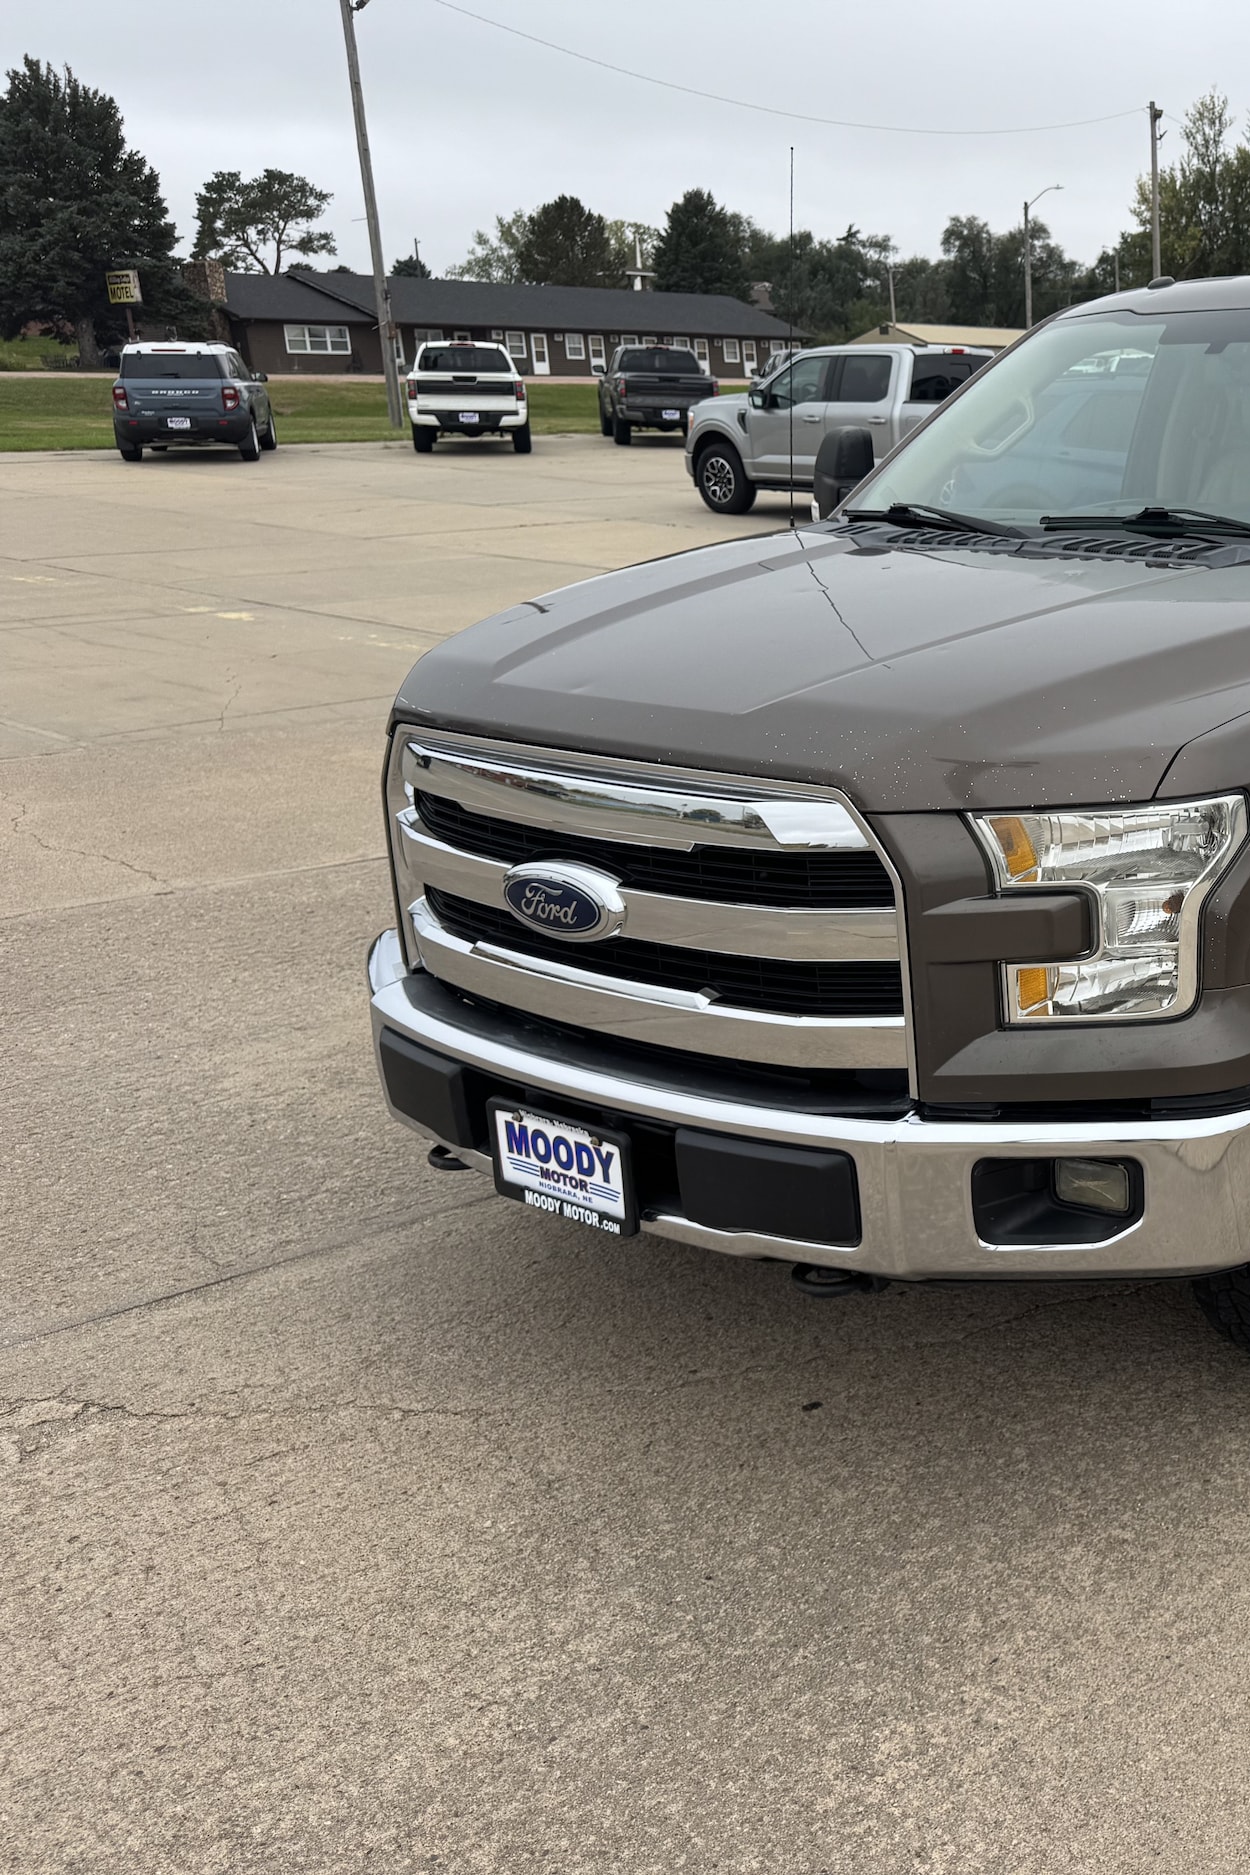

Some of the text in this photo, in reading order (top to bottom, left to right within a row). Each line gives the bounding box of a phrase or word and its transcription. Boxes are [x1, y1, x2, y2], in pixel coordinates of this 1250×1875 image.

[109, 286, 134, 300] MOTEL
[521, 882, 578, 924] Ford
[504, 1120, 614, 1184] MOODY
[538, 1180, 594, 1204] NIOBRARA, NE
[539, 1166, 590, 1194] MOTOR
[524, 1189, 561, 1215] MOODY
